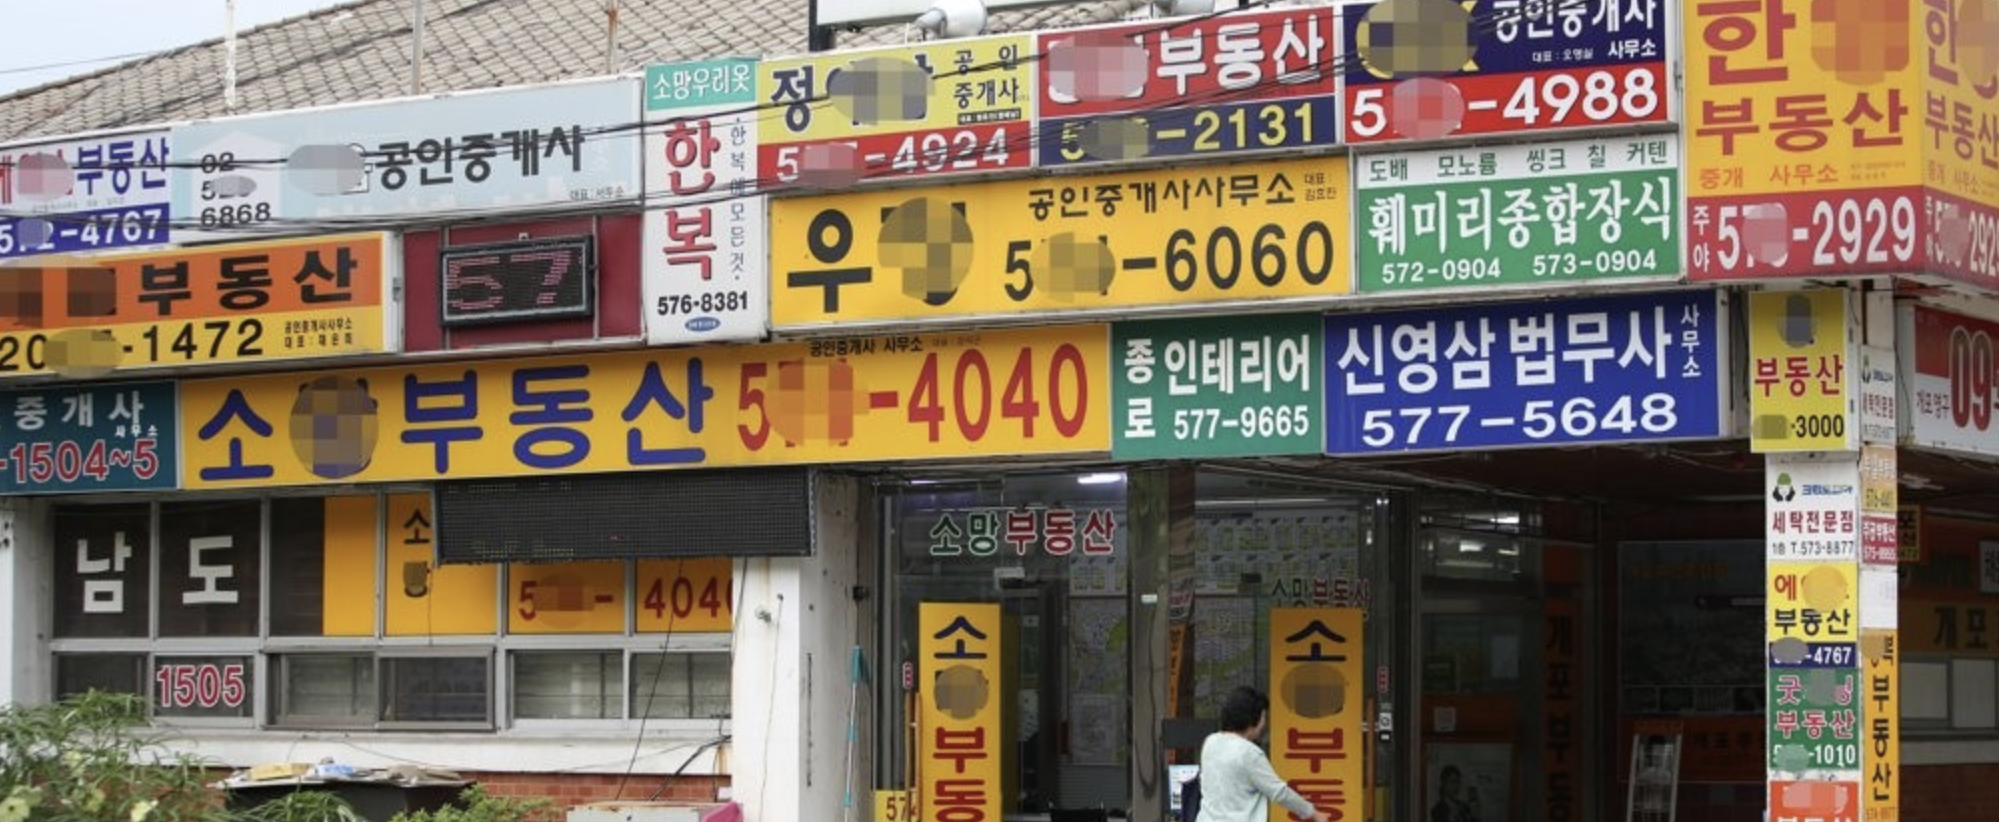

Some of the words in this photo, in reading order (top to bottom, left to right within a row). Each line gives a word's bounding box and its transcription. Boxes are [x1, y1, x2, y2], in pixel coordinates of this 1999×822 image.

[1493, 0, 1655, 43] 공인중개사
[1697, 0, 1909, 86] 한
[953, 45, 1018, 75] 공인
[1608, 38, 1657, 60] 사무소
[653, 64, 749, 100] 소망우리옷
[953, 78, 1019, 110] 중개사
[1351, 68, 1658, 137] 5-4988
[1060, 102, 1314, 161] 5-2131
[1695, 88, 1909, 156] 부동산
[201, 152, 235, 174] 02
[375, 125, 585, 190] 공인중개사
[776, 128, 1010, 183] 5-4924
[1369, 157, 1408, 182] 도배
[1437, 152, 1498, 178] 모노륨
[1526, 149, 1567, 173] 씽크
[1587, 144, 1607, 169] 칠
[1626, 139, 1668, 166] 커텐
[1699, 167, 1744, 189] 중개
[1770, 164, 1838, 186] 사무소
[201, 202, 271, 228] 6868
[662, 117, 722, 281] 한복
[1029, 173, 1295, 221] 공인중개사사무소
[1368, 176, 1671, 257] 훼미리종합장식
[0, 209, 162, 253] 5-4767
[1717, 196, 1917, 271] 5-2929
[448, 251, 571, 310] 57
[787, 201, 968, 313] 우
[1004, 221, 1335, 302] 5-6060
[1382, 257, 1502, 285] 572-0904
[1532, 249, 1658, 277] 573-0904
[0, 317, 264, 371] 20-1472
[810, 338, 876, 358] 공인중개사
[884, 336, 924, 354] 사무소
[1164, 334, 1310, 396] 인테리어
[1337, 317, 1497, 396] 신영삼
[1509, 305, 1673, 386] 법무사
[1680, 304, 1702, 379] 사무소
[737, 342, 1089, 452] 5-4040
[1124, 338, 1156, 439] 종로
[1755, 354, 1844, 398] 부동산
[1951, 326, 1999, 432] 09
[14, 390, 144, 430] 중개사
[115, 424, 158, 438] 사무소
[199, 357, 714, 481] 소부동산
[1174, 404, 1310, 441] 577-9665
[1362, 392, 1678, 448] 577-5648
[930, 508, 1115, 557] 소망부동산
[1772, 510, 1854, 534] 세탁전문점
[1773, 608, 1852, 636] 부동산
[1773, 646, 1853, 664] -4767
[156, 664, 245, 708] 1505
[933, 615, 988, 822] 소부동
[1284, 619, 1347, 822] 소부동
[1776, 710, 1856, 739] 부동산
[1872, 675, 1892, 802] 부동산
[1773, 743, 1856, 768] -1010
